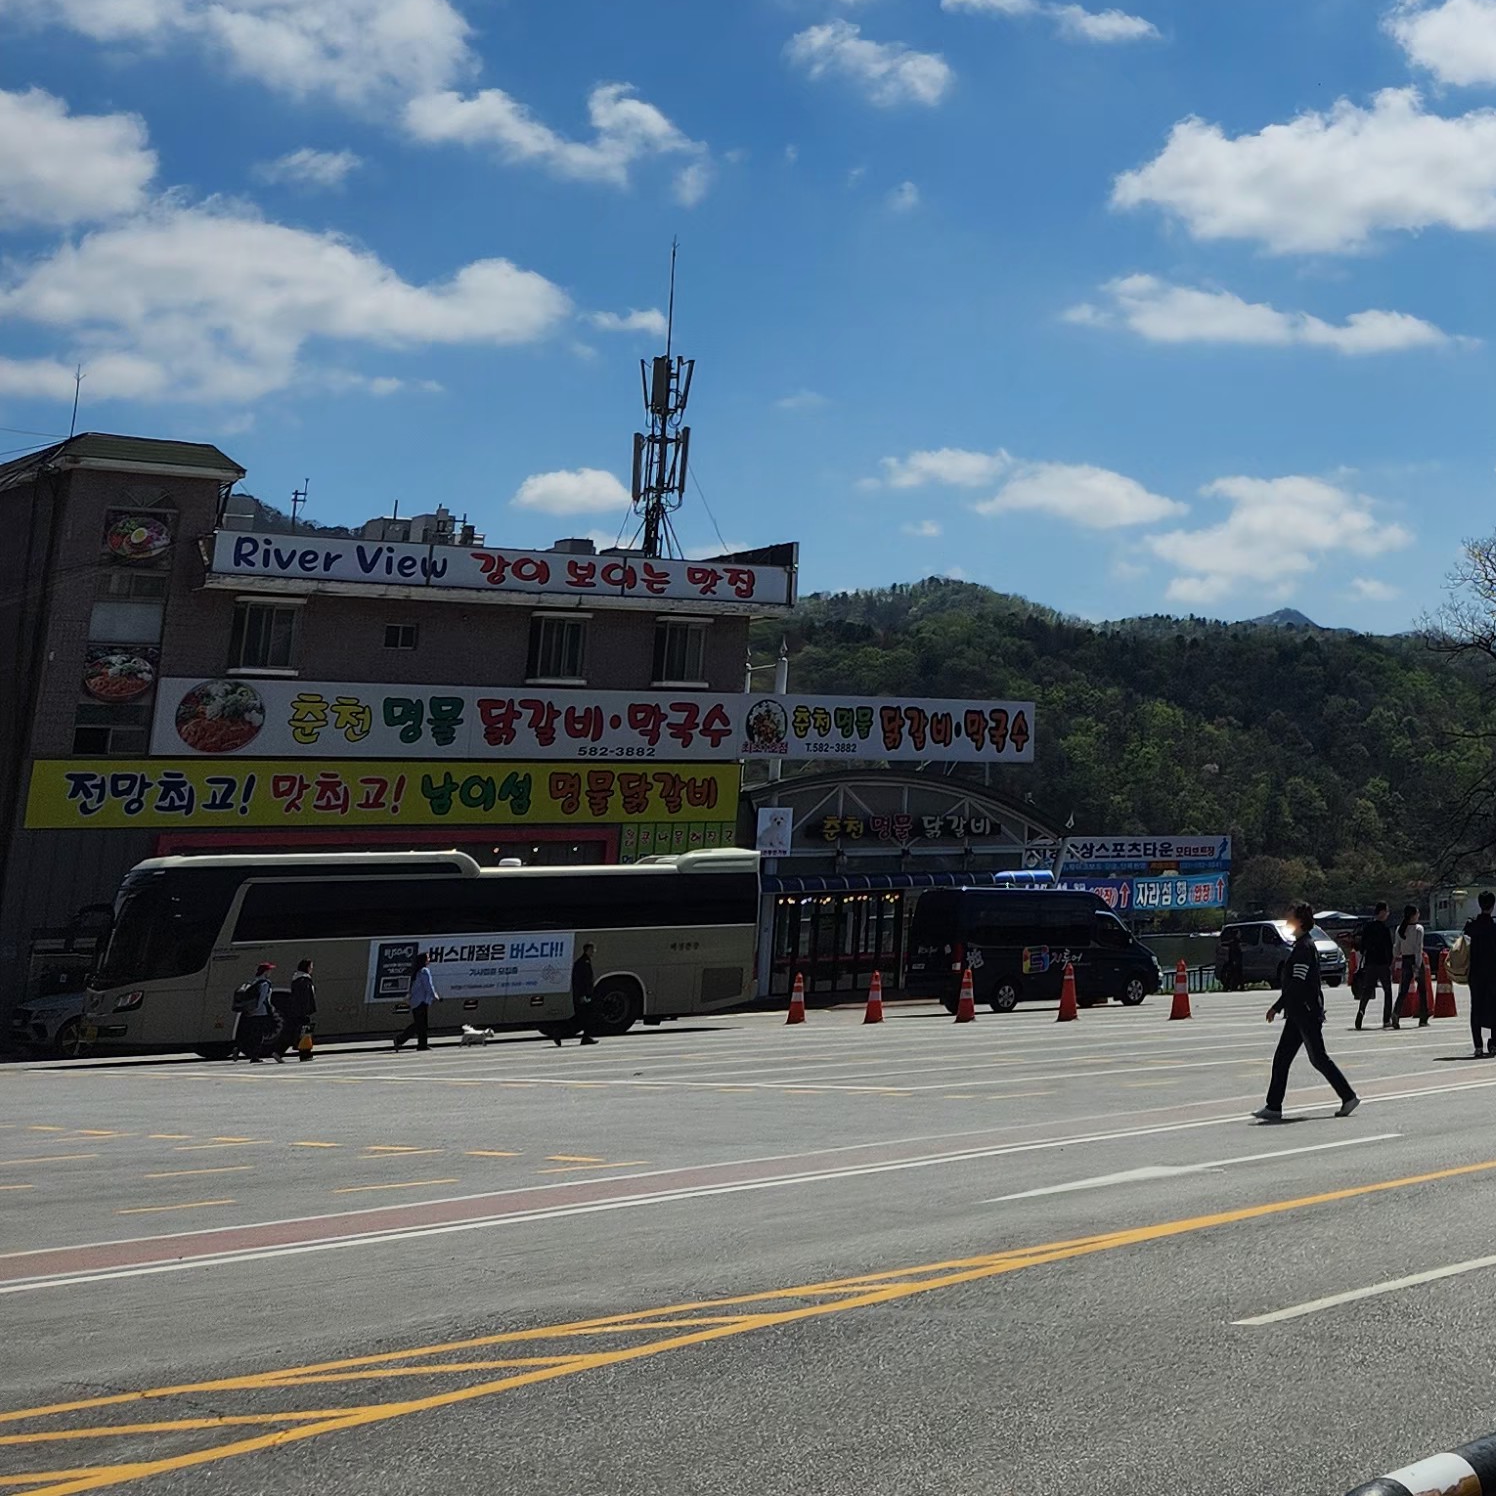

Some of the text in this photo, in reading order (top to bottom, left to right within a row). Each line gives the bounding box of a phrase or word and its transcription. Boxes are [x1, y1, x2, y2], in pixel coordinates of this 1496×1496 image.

[233, 536, 756, 598] River View 강이 보이는 맛집
[288, 693, 373, 745] 춘천
[382, 696, 465, 747] 명물
[577, 746, 656, 757] 582-3882
[65, 771, 257, 816] 전망최고!
[272, 771, 406, 815] 맛최고!
[421, 771, 531, 816] 남이섬
[822, 814, 991, 841] 춘천 명물 닭갈비
[1136, 881, 1173, 907] 자라섬
[1177, 880, 1188, 906] 행
[428, 943, 506, 963] 버스대절은
[508, 941, 564, 960] 버스다!!
